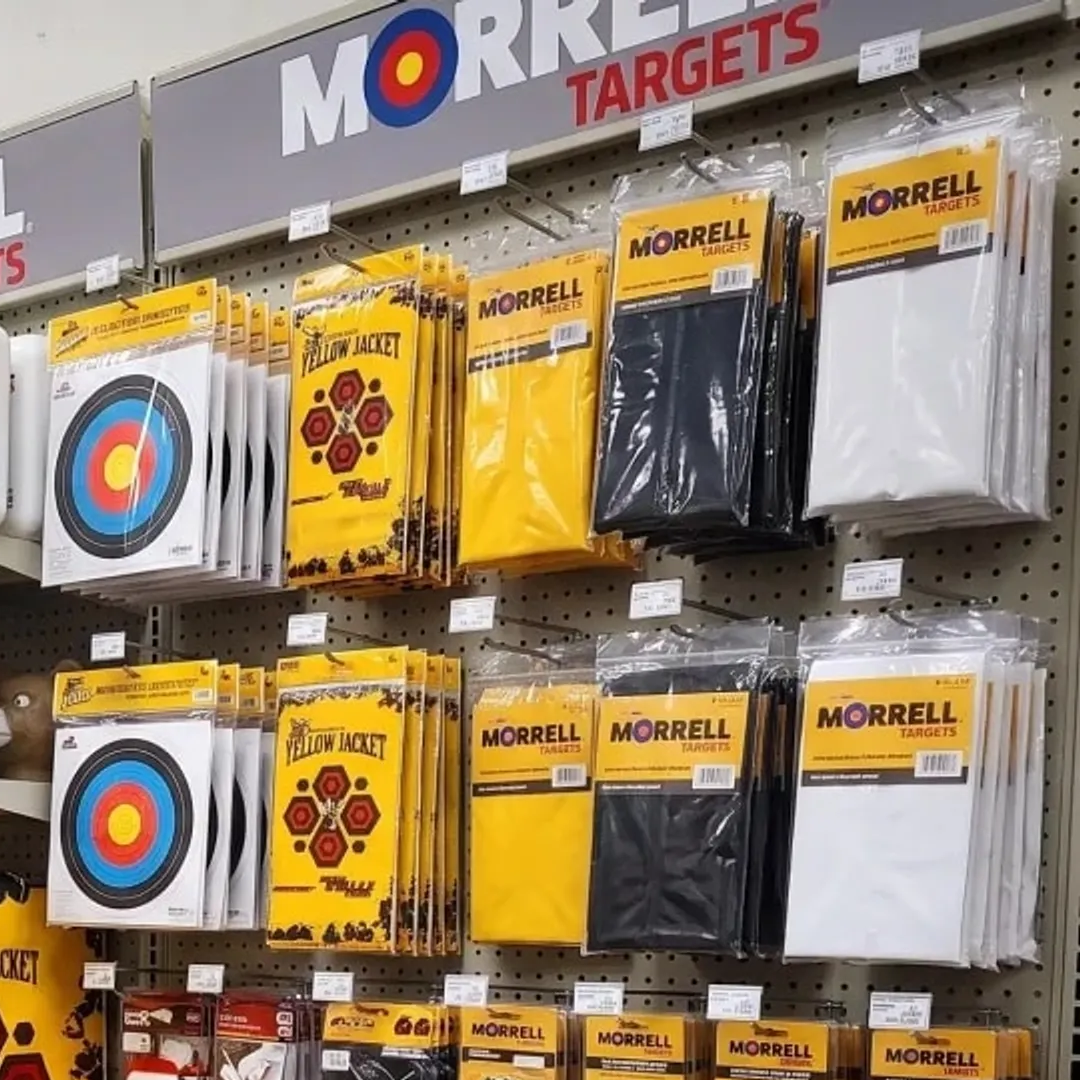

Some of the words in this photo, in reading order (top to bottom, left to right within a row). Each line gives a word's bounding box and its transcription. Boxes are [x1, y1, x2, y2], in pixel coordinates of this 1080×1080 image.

[566, 3, 820, 127] TARGETS
[842, 170, 982, 222] MORRELL
[924, 195, 981, 216] TARGETS
[629, 218, 751, 259] MORRELL
[702, 240, 750, 257] TARGETS
[478, 278, 583, 320] MORRELL
[301, 336, 350, 378] YELLOW
[352, 332, 401, 360] JACKET
[817, 702, 957, 729] MORRELL
[482, 723, 581, 747] MORRELL
[610, 718, 731, 743] MORRELL
[900, 727, 957, 739] TARGETS
[286, 733, 338, 766] YELLOW
[338, 732, 387, 760] JACKET
[681, 742, 731, 753] TARGETS
[472, 1023, 545, 1040] MORRELL
[598, 1032, 672, 1049] MORRELL
[729, 1040, 813, 1059] MORRELL
[886, 1048, 979, 1067] MORRELL
